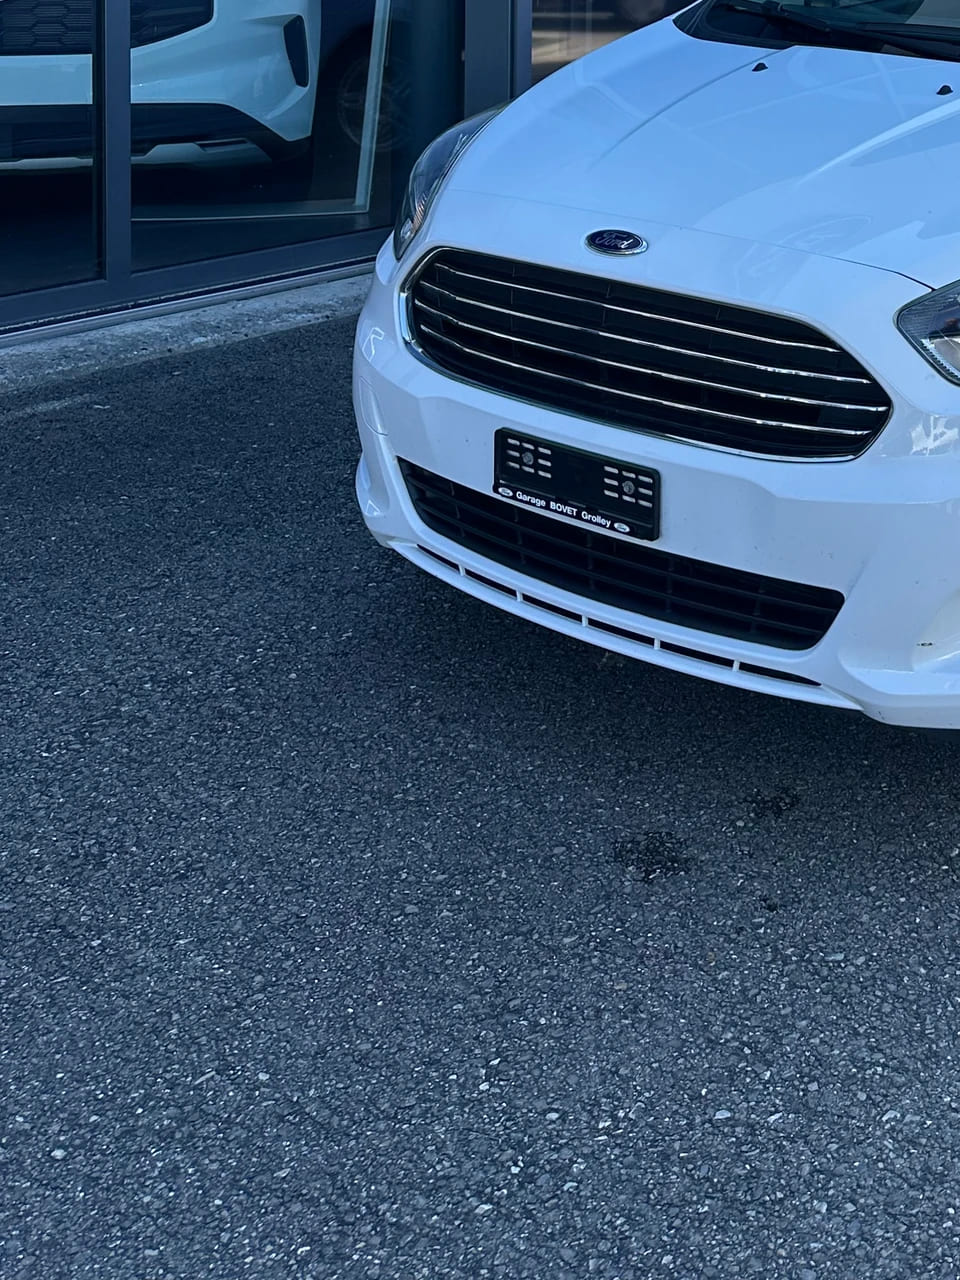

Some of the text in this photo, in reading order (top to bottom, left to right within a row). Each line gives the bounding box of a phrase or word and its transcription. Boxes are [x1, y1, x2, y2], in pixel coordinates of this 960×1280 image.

[595, 231, 634, 249] Ford
[516, 491, 546, 507] Garage
[550, 501, 578, 517] BOVET
[581, 511, 611, 528] Grolley
